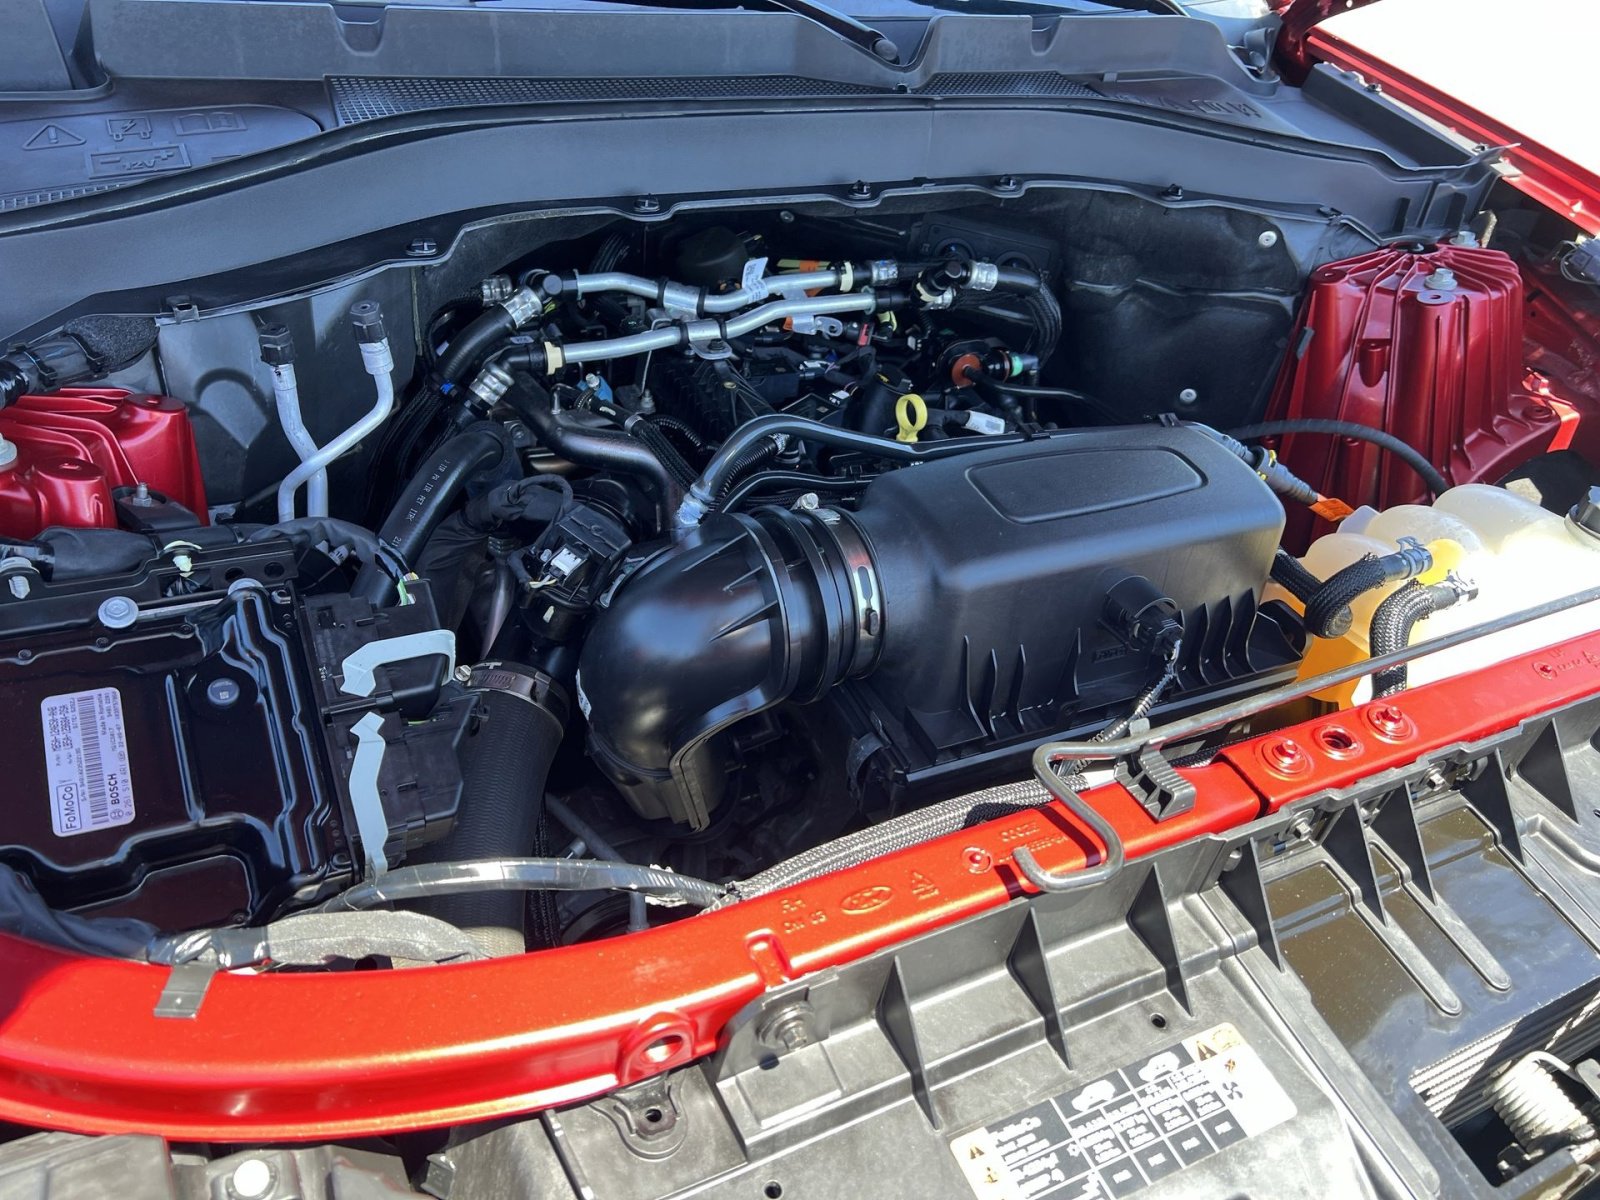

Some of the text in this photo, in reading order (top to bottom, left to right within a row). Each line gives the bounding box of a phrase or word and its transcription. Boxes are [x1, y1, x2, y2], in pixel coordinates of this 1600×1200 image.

[122, 159, 157, 170] 12V
[96, 693, 104, 715] Romania
[107, 773, 120, 805] BOSCH
[61, 785, 77, 829] FoMoCo
